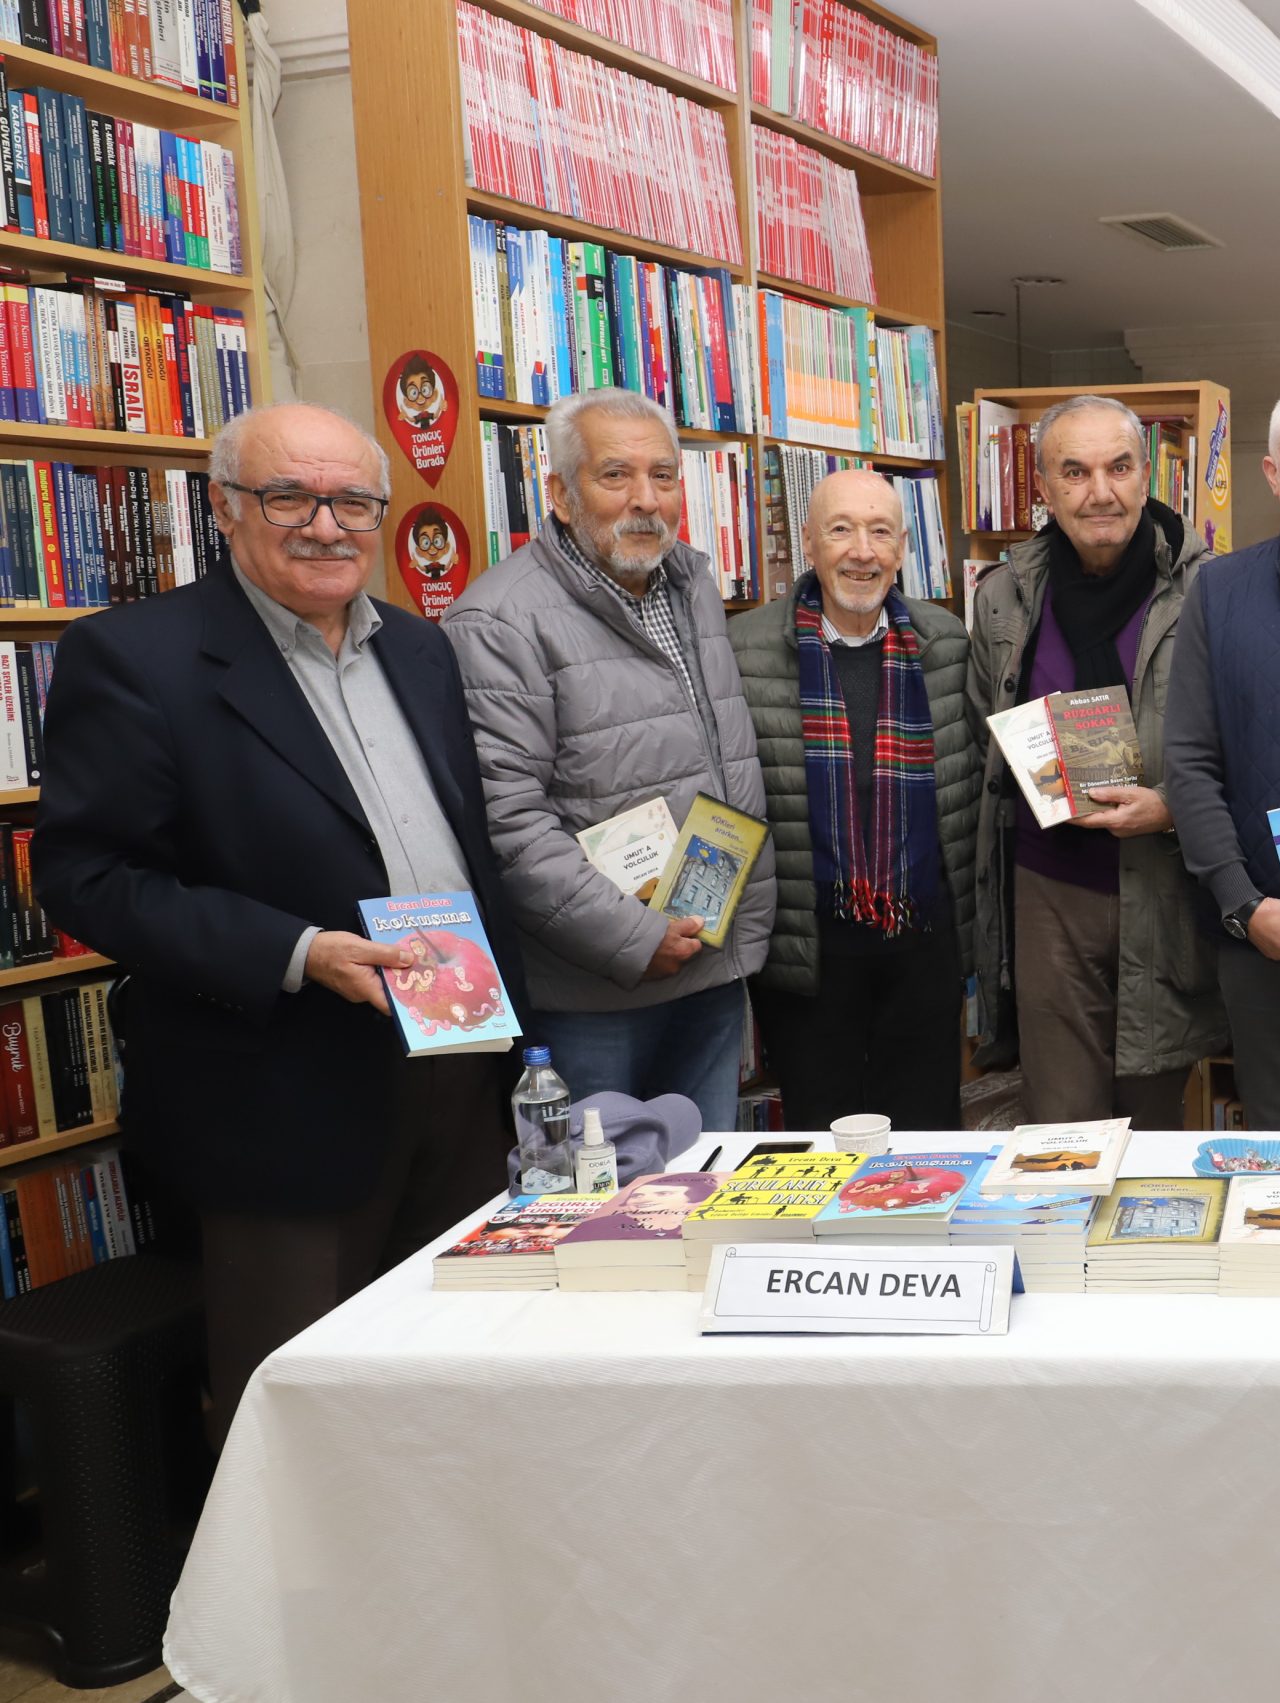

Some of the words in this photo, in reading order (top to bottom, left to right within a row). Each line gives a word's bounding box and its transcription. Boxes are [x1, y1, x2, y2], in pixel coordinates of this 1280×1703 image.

[0, 117, 12, 172] GÜVENLİK
[11, 104, 24, 170] KARADENİZ
[19, 304, 28, 322] Yeni
[22, 325, 30, 349] Kamu
[122, 327, 130, 359] SİYASETİNDE
[3, 350, 12, 386] Yönetimi
[144, 336, 152, 379] ORTADOĞU
[156, 339, 165, 380] ORTADOĞU
[24, 352, 34, 388] Yönetimi
[123, 364, 143, 421] İSRAİL
[412, 431, 442, 443] TONGUÇ
[412, 442, 445, 459] Ürünleri
[416, 456, 444, 469] Burada
[39, 469, 48, 501] Dindarca
[42, 502, 53, 536] Öldürmek
[132, 501, 140, 528] POLİTİKA
[422, 582, 452, 592] TONGUÇ
[422, 594, 454, 606] Ürünleri
[1, 655, 10, 669] BAZI
[3, 671, 11, 695] ŞEYLER
[6, 696, 14, 722] ÜZERİNE
[1070, 698, 1090, 706] Abbas
[1092, 694, 1109, 703] SATIR
[1074, 718, 1116, 730] SOKAK
[1088, 779, 1109, 787] Dönemin
[711, 816, 735, 830] KÖKleri
[623, 852, 659, 870] YOLCULUK
[387, 902, 420, 912] Ercan
[421, 898, 452, 908] Deva
[372, 910, 472, 931] kokuşma
[2, 1022, 24, 1072] Buyruk
[721, 1180, 825, 1192] SORULARIN
[768, 1194, 828, 1205] DANSI
[766, 1269, 870, 1296] ERCAN
[879, 1274, 961, 1298] DEVA
